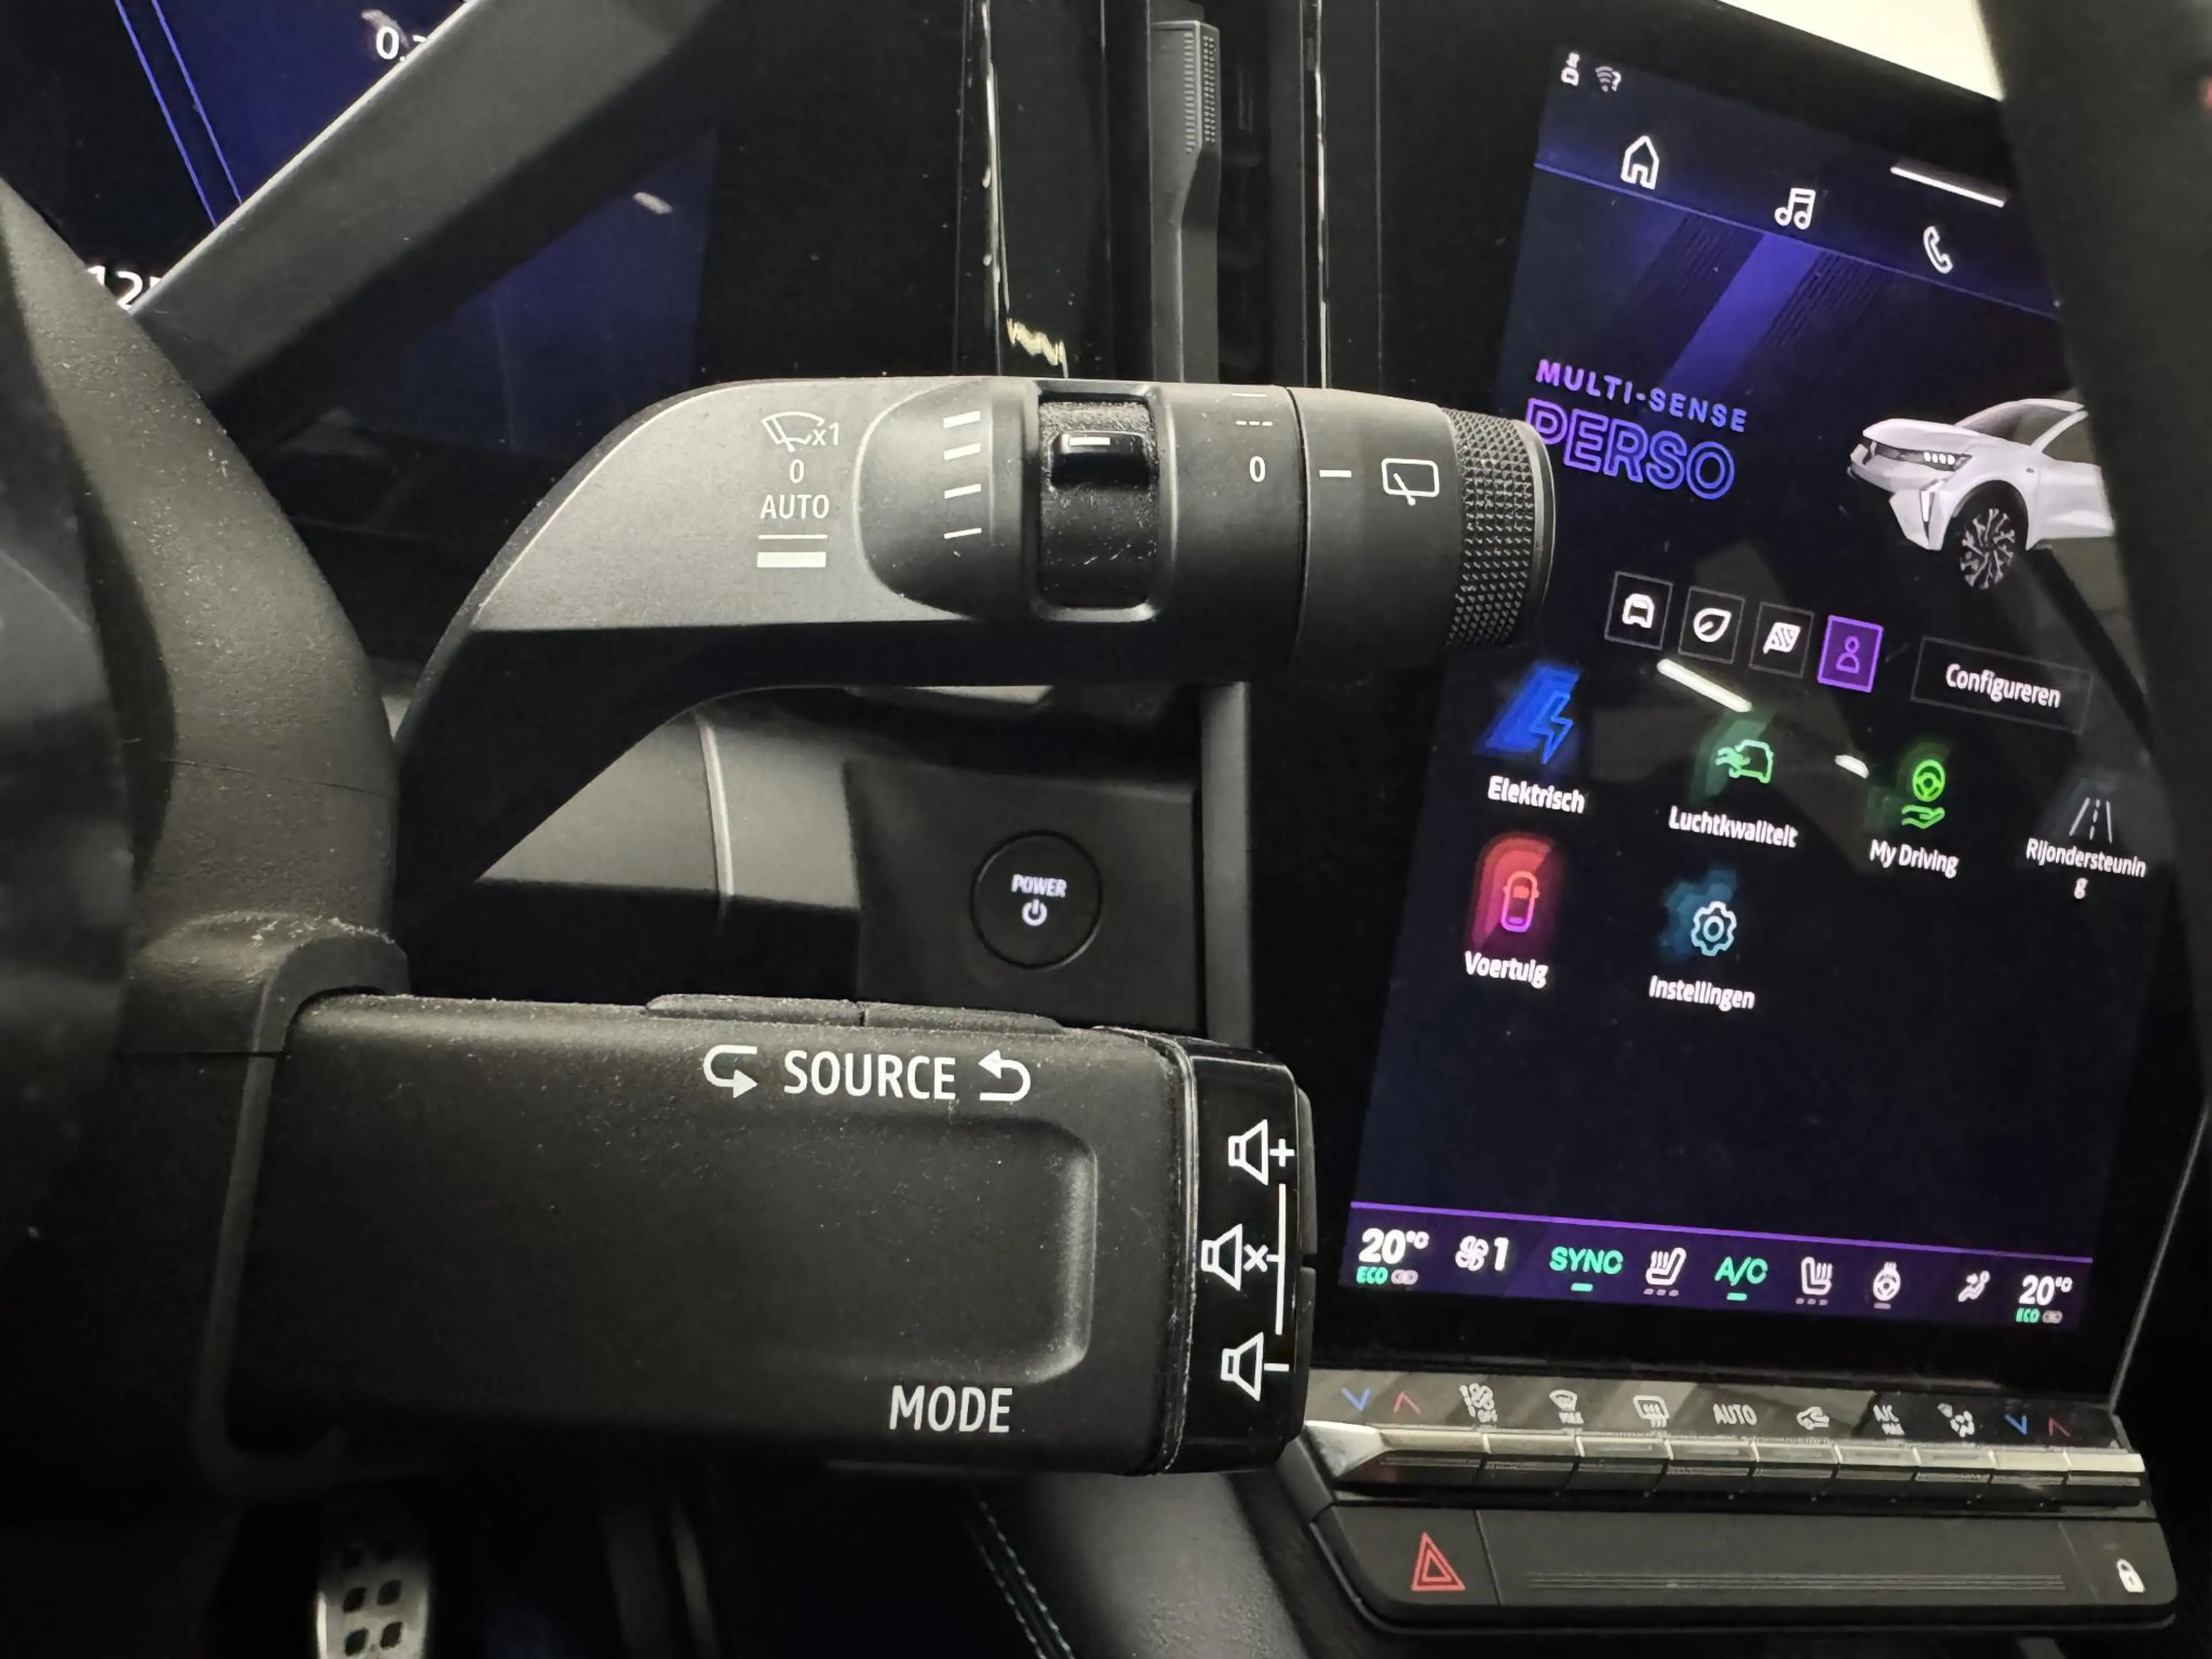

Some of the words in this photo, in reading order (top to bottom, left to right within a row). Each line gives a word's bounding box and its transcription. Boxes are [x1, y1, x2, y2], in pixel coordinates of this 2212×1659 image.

[376, 26, 427, 62] 0.
[1535, 359, 1748, 433] MULTI-SENSE
[812, 421, 840, 446] x1
[1525, 397, 1736, 500] PERSO
[760, 494, 830, 520] AUTO
[1945, 662, 2062, 709] Configureren
[1487, 775, 1586, 815] Elektrisch
[1668, 805, 1800, 848] Luchtkwaliteit
[1869, 839, 1897, 869] My
[1898, 843, 1960, 879] Driving
[2025, 837, 2146, 878] Rijondersteunin
[1011, 873, 1067, 898] POWER
[1464, 950, 1550, 990] Voertuig
[1649, 974, 1756, 1012] Instellingen
[784, 1050, 956, 1100] SOURCE
[1494, 1236, 1509, 1271] 1
[1550, 1246, 1624, 1275] SYNC
[1714, 1256, 1768, 1286] A/C
[1356, 1266, 1389, 1285] ECO
[889, 1385, 1013, 1433] MODE
[1713, 1403, 1758, 1426] AUTO
